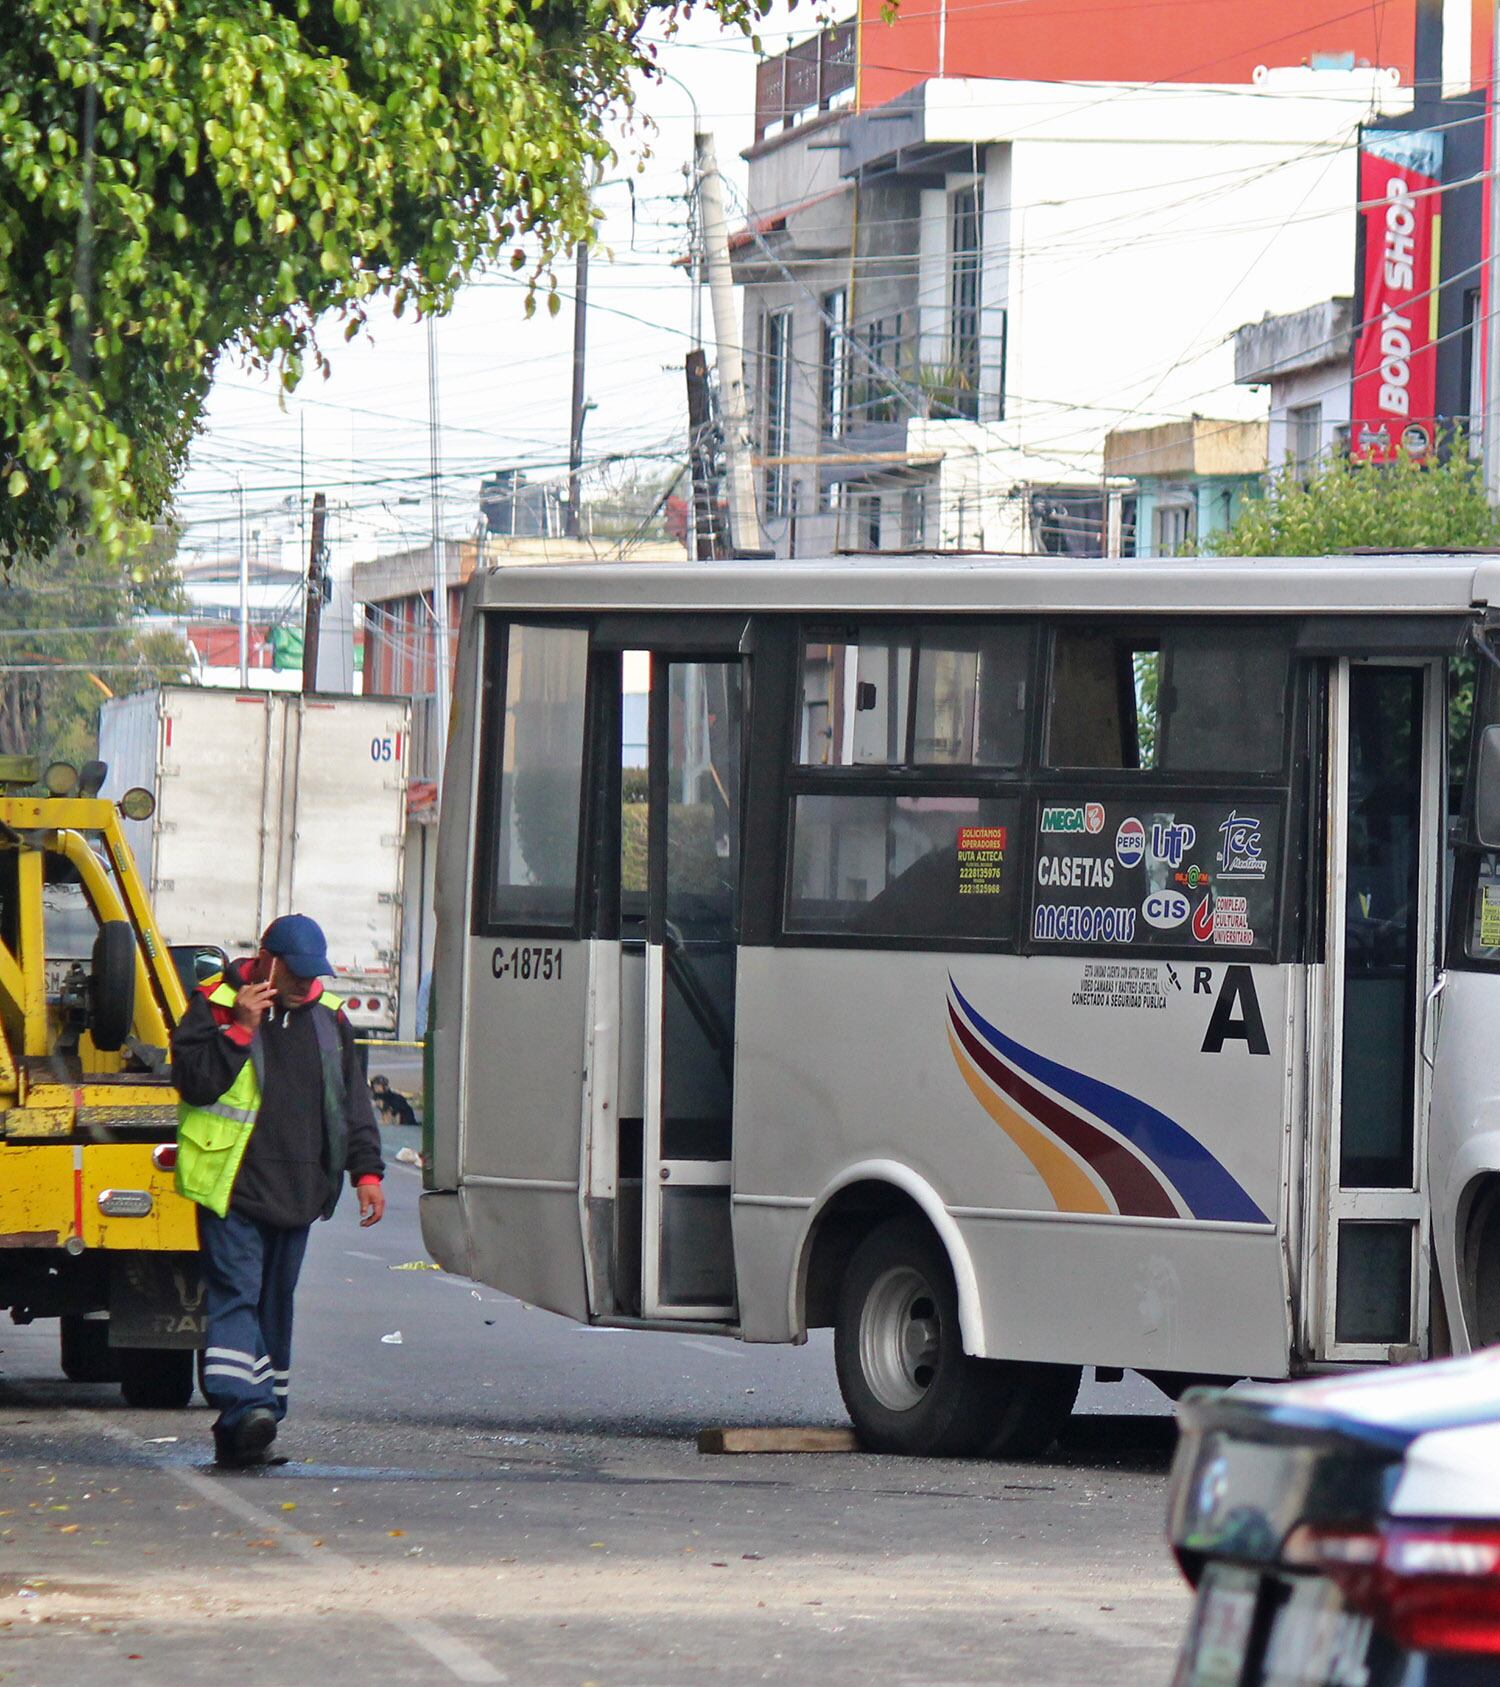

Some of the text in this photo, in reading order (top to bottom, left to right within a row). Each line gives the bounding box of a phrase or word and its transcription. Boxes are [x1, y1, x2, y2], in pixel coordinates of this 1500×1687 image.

[1378, 177, 1416, 415] BODY SHOP
[371, 737, 392, 762] 05
[1041, 808, 1085, 832] MEGA
[963, 829, 1001, 838] SOLICITAMOS
[1117, 836, 1144, 848] PEPSI
[962, 839, 1001, 849] OPERADORES
[958, 851, 1003, 861] RUTA AZTECA
[1038, 856, 1115, 888] CASETAS
[1147, 899, 1186, 918] CIS
[1216, 898, 1246, 911] COMPLEJO
[1034, 905, 1136, 942] ANGELOPOLIS
[1215, 914, 1247, 927] CULTURAL
[1215, 930, 1253, 944] UNIVERSITARIO
[492, 947, 562, 980] C-18751
[1080, 979, 1093, 992] VIDEO
[1193, 967, 1213, 994] R
[1072, 993, 1105, 1006] CONECTADO
[1106, 994, 1110, 1006] A
[1111, 994, 1142, 1008] SEGURIDAD
[1201, 965, 1271, 1055] A
